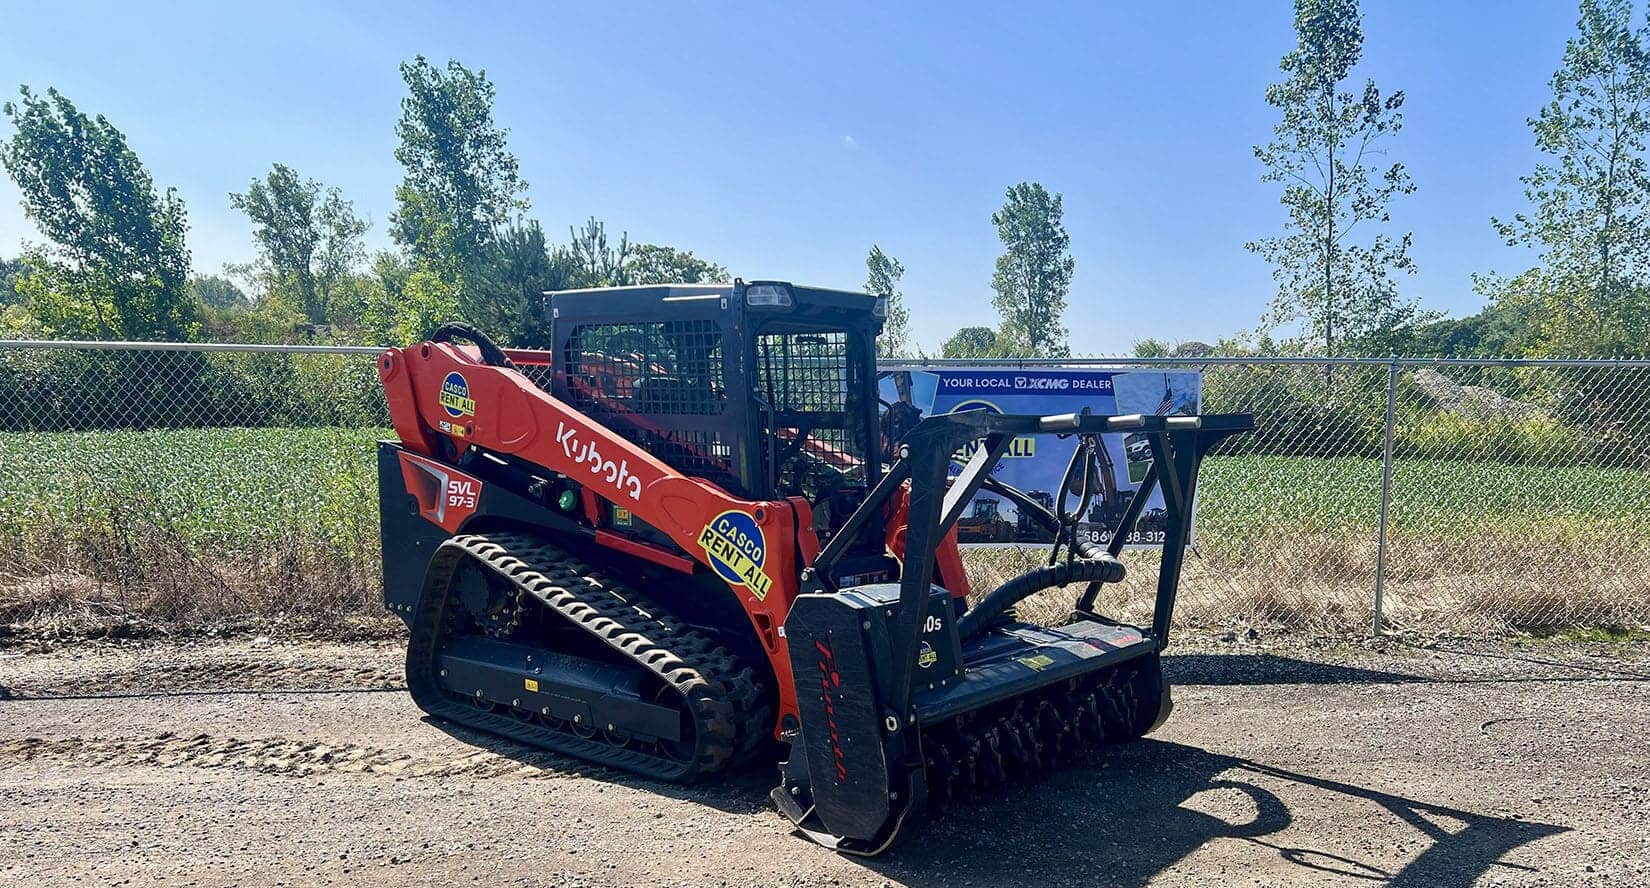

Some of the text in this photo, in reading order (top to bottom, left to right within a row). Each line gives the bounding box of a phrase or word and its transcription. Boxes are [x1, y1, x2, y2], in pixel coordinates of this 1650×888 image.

[445, 381, 467, 396] CASCO
[943, 378, 1112, 390] YOUR LOCAL XCMG DEALER
[440, 391, 474, 412] RENT ALL
[556, 421, 642, 500] Kubota
[448, 480, 476, 497] SVL
[449, 496, 475, 508] 97-3
[718, 519, 762, 561] CASCO
[701, 528, 744, 567] RENT
[744, 566, 769, 595] ALL
